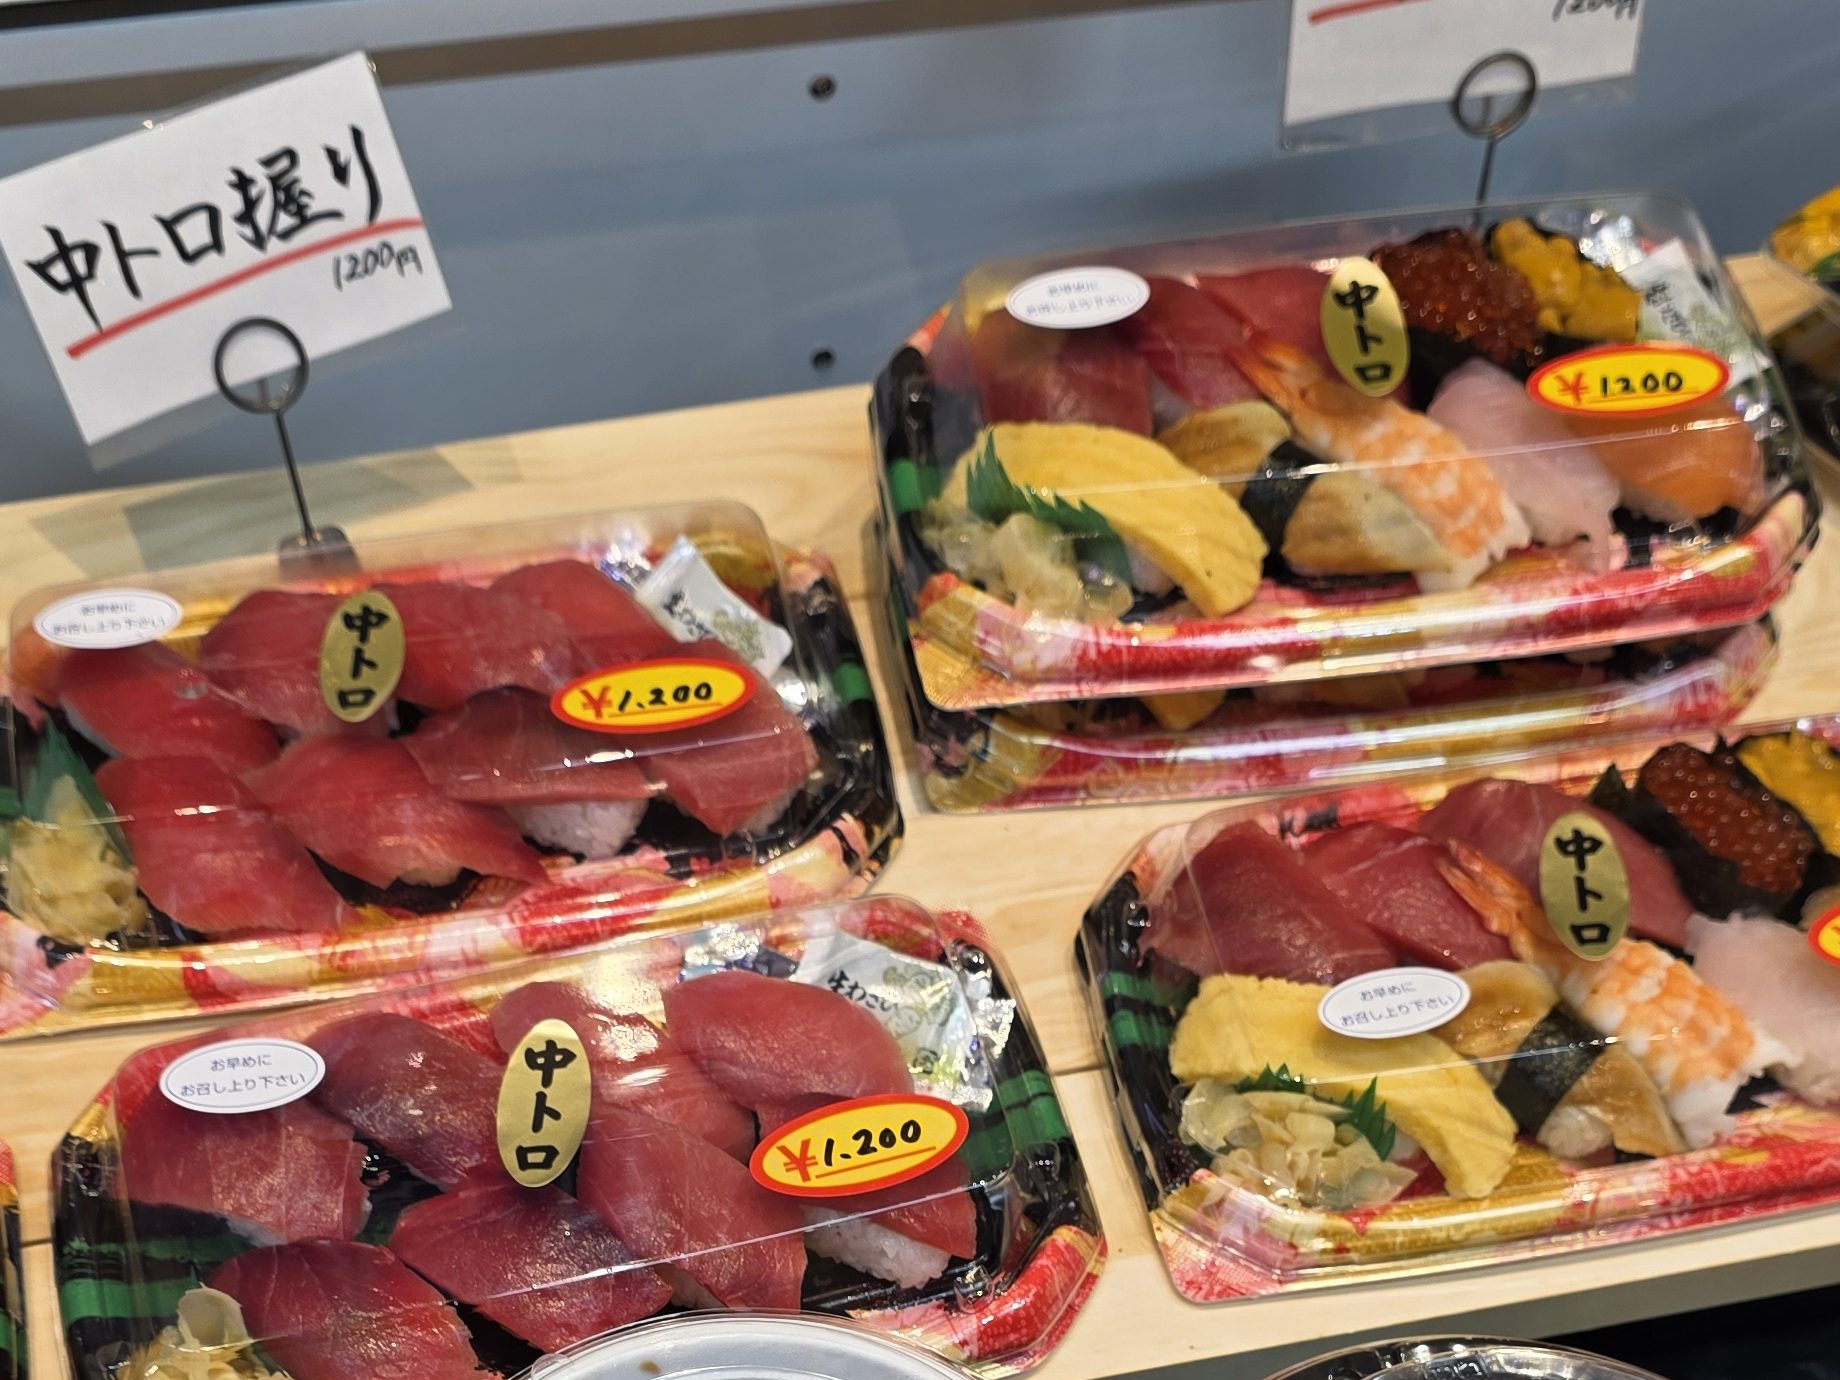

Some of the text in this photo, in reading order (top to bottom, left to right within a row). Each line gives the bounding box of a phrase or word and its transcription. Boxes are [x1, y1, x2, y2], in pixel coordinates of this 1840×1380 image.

[26, 125, 382, 332] 中トロ握り
[333, 240, 423, 291] 1200円
[1335, 280, 1391, 384] 中トロ
[337, 605, 390, 710] 中トロ
[1555, 829, 1611, 945] 中トロ
[181, 1073, 306, 1098] お召し上り下さい
[210, 1054, 272, 1071] お早めに
[515, 1040, 577, 1171] 中トロ
